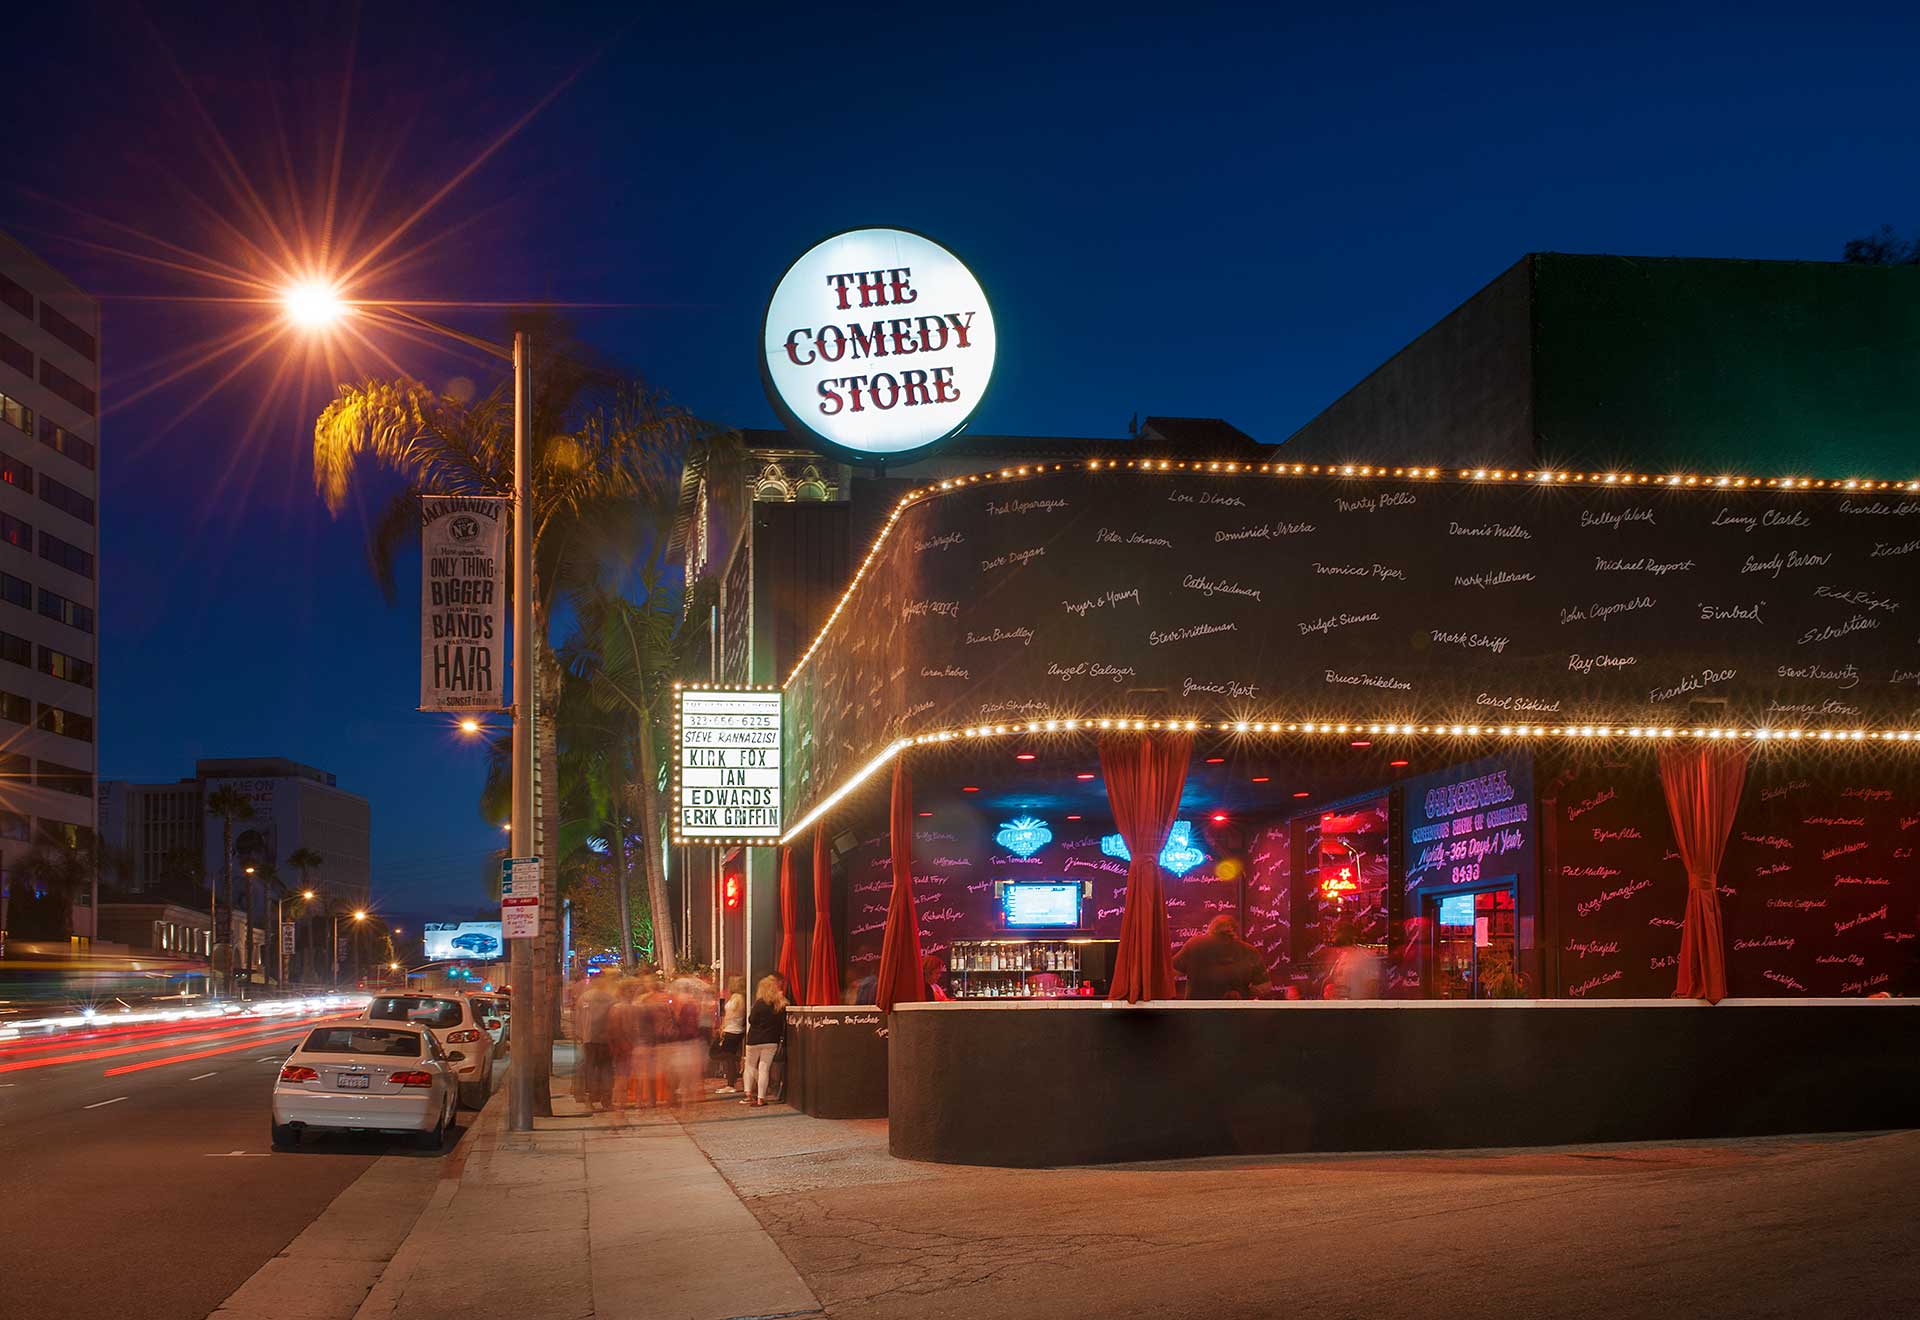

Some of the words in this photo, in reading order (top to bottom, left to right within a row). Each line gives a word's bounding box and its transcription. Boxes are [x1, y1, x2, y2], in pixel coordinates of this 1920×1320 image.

[826, 267, 917, 310] THE
[784, 312, 976, 366] COMEDY
[817, 367, 961, 416] STORE
[986, 502, 1008, 515] Fred
[1335, 496, 1376, 513] Marty
[1762, 508, 1812, 527] Clarke
[1096, 528, 1122, 542] Peter
[1126, 533, 1172, 548] Johnson
[1215, 527, 1271, 542] Dominick
[1450, 522, 1493, 536] Dennis
[1494, 524, 1532, 540] Miller
[431, 557, 456, 578] ONLY
[462, 557, 494, 578] THING
[1312, 562, 1369, 576] Monica
[1372, 564, 1408, 581] Piper
[1596, 557, 1644, 570] Michael
[1742, 553, 1784, 579] Sandy
[1787, 550, 1832, 568] Baron
[1183, 574, 1214, 596] Cathy
[1454, 574, 1485, 589] Mark
[431, 578, 494, 606] BIGGER
[1106, 588, 1140, 606] Young
[1560, 606, 1586, 624] John
[432, 614, 493, 640] BANDS
[1298, 616, 1338, 636] Bridget
[1797, 614, 1880, 645] Sebastian
[993, 627, 1036, 645] Bradley
[1150, 631, 1181, 646] Steve
[1430, 630, 1466, 647] Mark
[1468, 634, 1510, 654] Schiff
[434, 646, 492, 691] HAIR
[1090, 664, 1136, 682] Salazar
[1568, 654, 1594, 674] Ray
[1596, 655, 1637, 670] Chapa
[1778, 666, 1810, 678] Steve
[1324, 670, 1361, 684] Bruce
[1649, 675, 1703, 703] Frankie
[1702, 669, 1737, 686] Pace
[1183, 678, 1227, 698] Janice
[1227, 681, 1260, 698] Hart
[1476, 692, 1510, 710] Carol
[685, 731, 713, 744] STEVE
[690, 750, 726, 766] KIRK
[741, 750, 766, 766] FOX
[721, 770, 745, 786] IAN
[692, 790, 771, 805] EDWARDS
[1425, 770, 1514, 820] ORIGINAL
[684, 810, 717, 825] ERIK
[725, 809, 778, 825] GRIFFIN
[1474, 813, 1485, 832] OF
[1486, 804, 1528, 828] COMEDIANS
[1469, 838, 1490, 863] Days
[1490, 832, 1498, 854] A
[1500, 829, 1525, 856] Year
[1064, 858, 1099, 872] Jimmie
[1098, 860, 1128, 876] Walker
[1452, 864, 1480, 884] 8433
